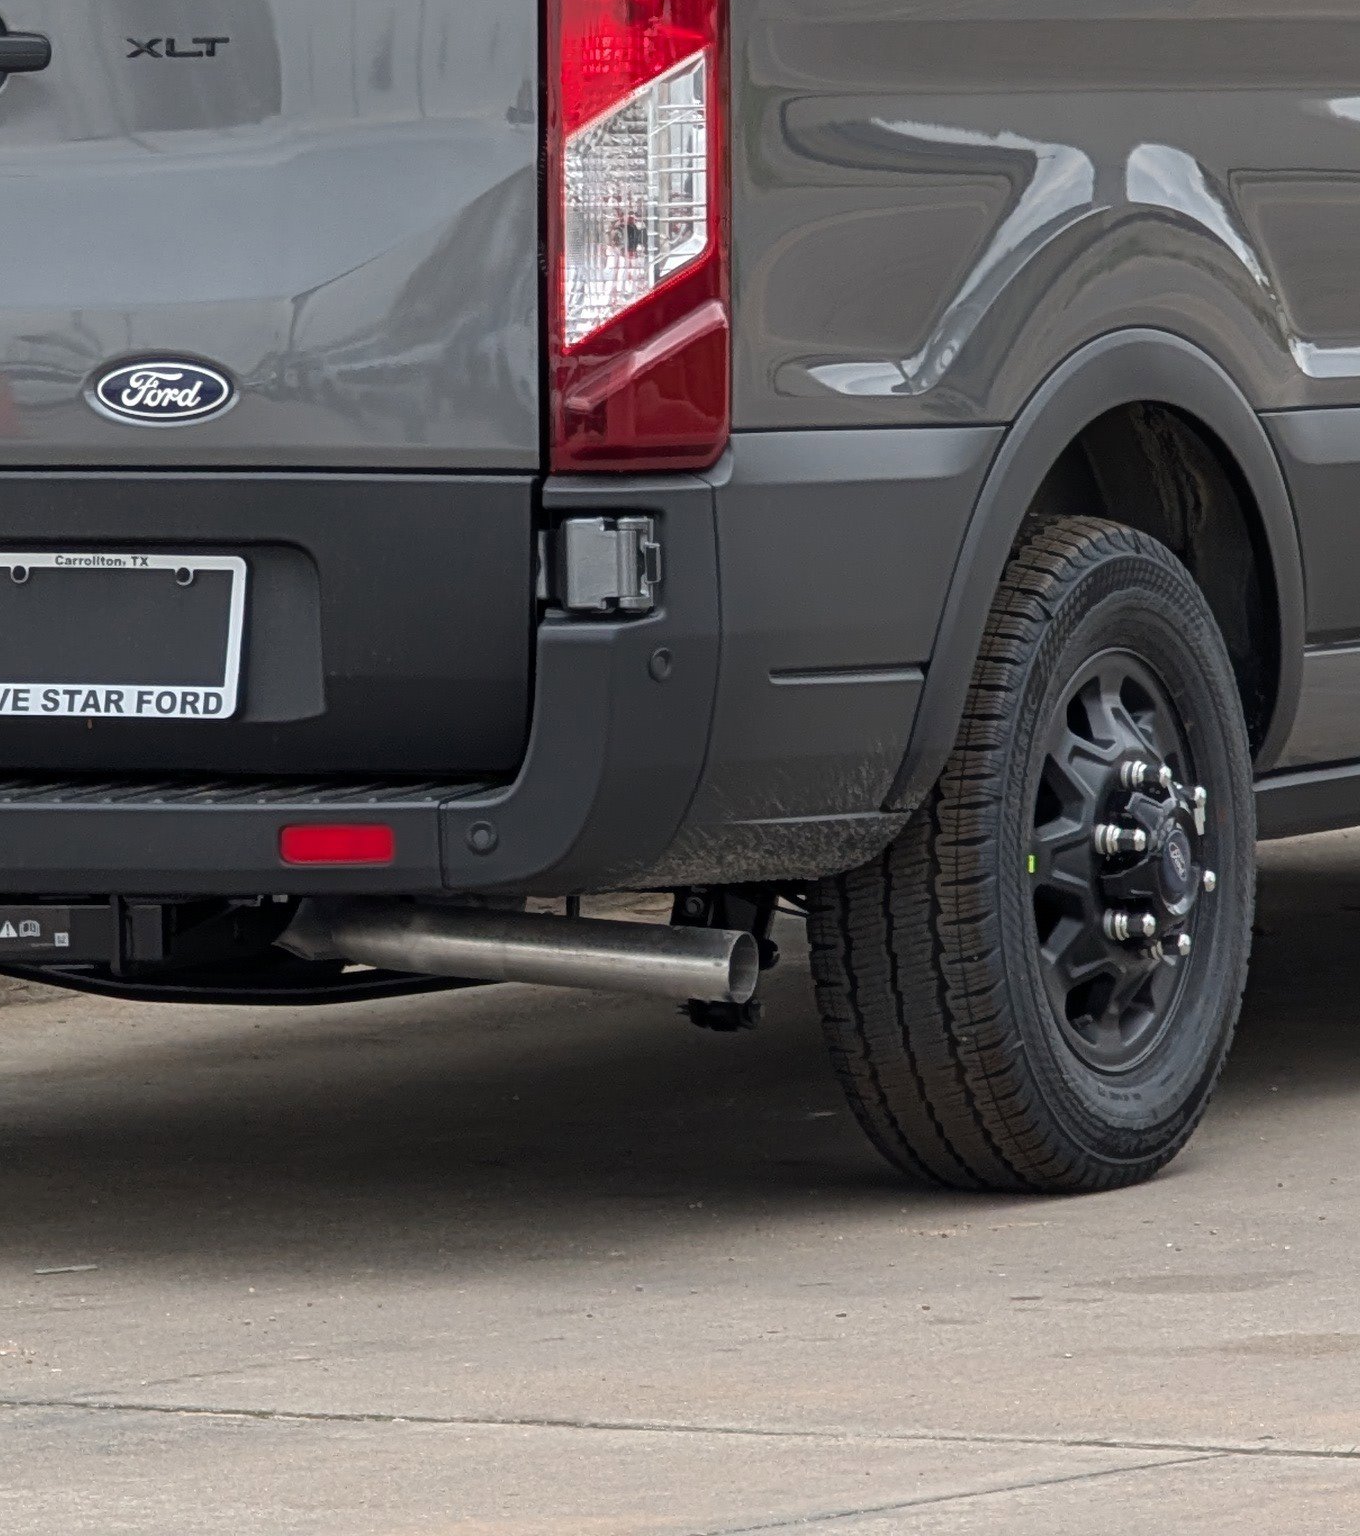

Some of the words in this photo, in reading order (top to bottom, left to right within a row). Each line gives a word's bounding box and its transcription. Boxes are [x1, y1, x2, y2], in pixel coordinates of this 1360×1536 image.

[126, 37, 229, 58] XLT
[121, 371, 203, 407] Ford
[131, 556, 150, 567] TX
[40, 688, 125, 714] STAR
[135, 690, 224, 715] FORD
